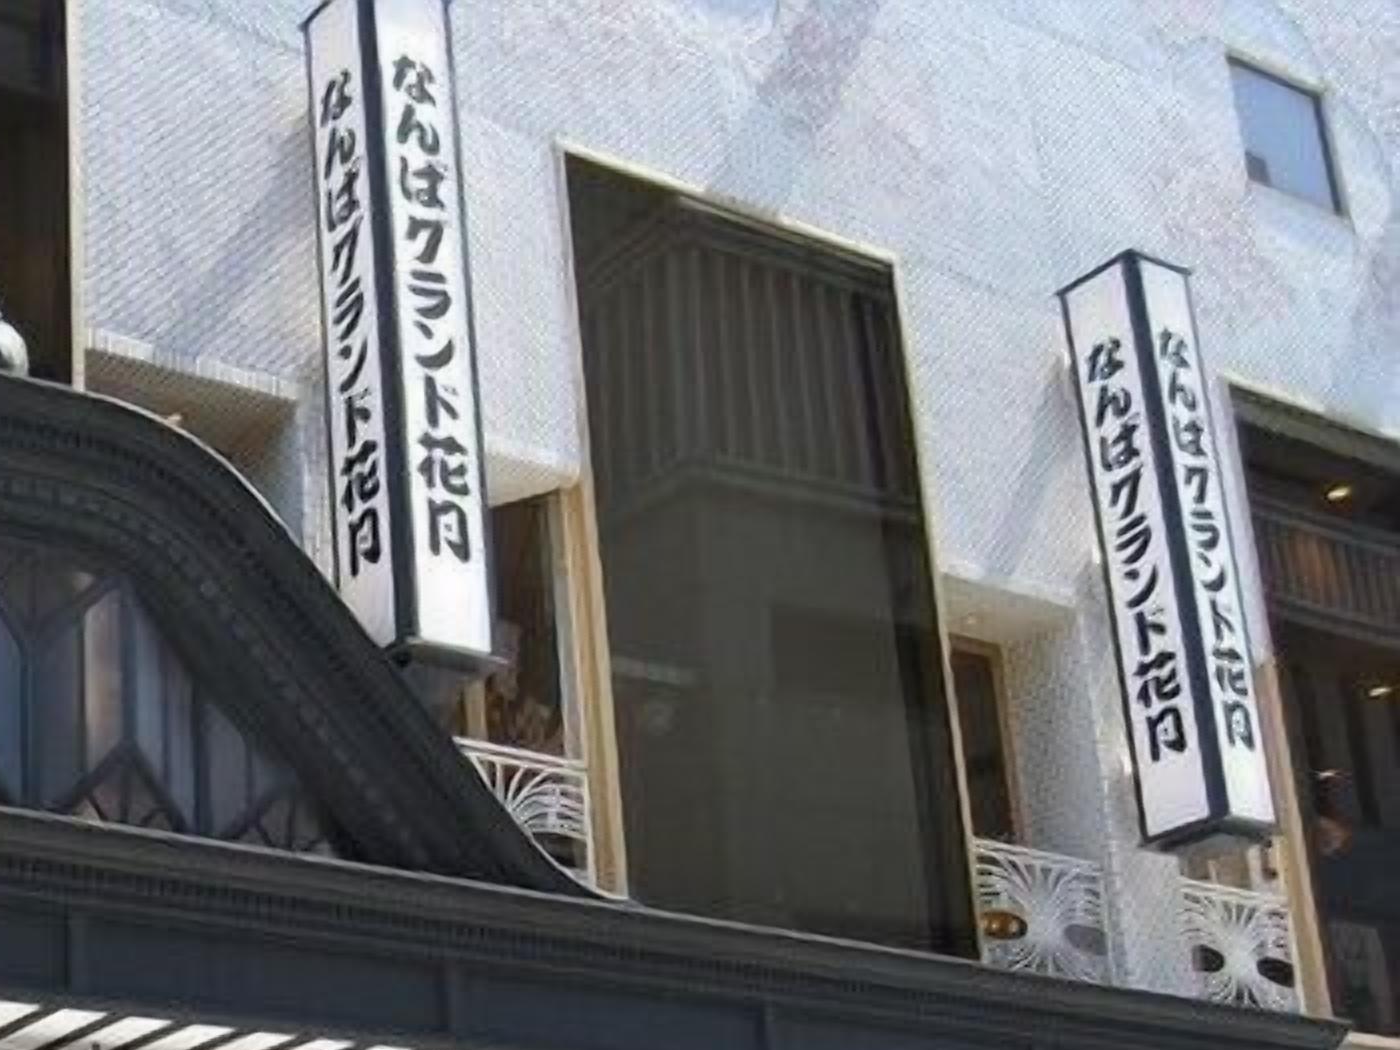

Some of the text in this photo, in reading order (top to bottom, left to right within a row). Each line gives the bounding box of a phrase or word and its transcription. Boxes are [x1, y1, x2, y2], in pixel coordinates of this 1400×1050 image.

[392, 54, 470, 563] なんばグランド花月
